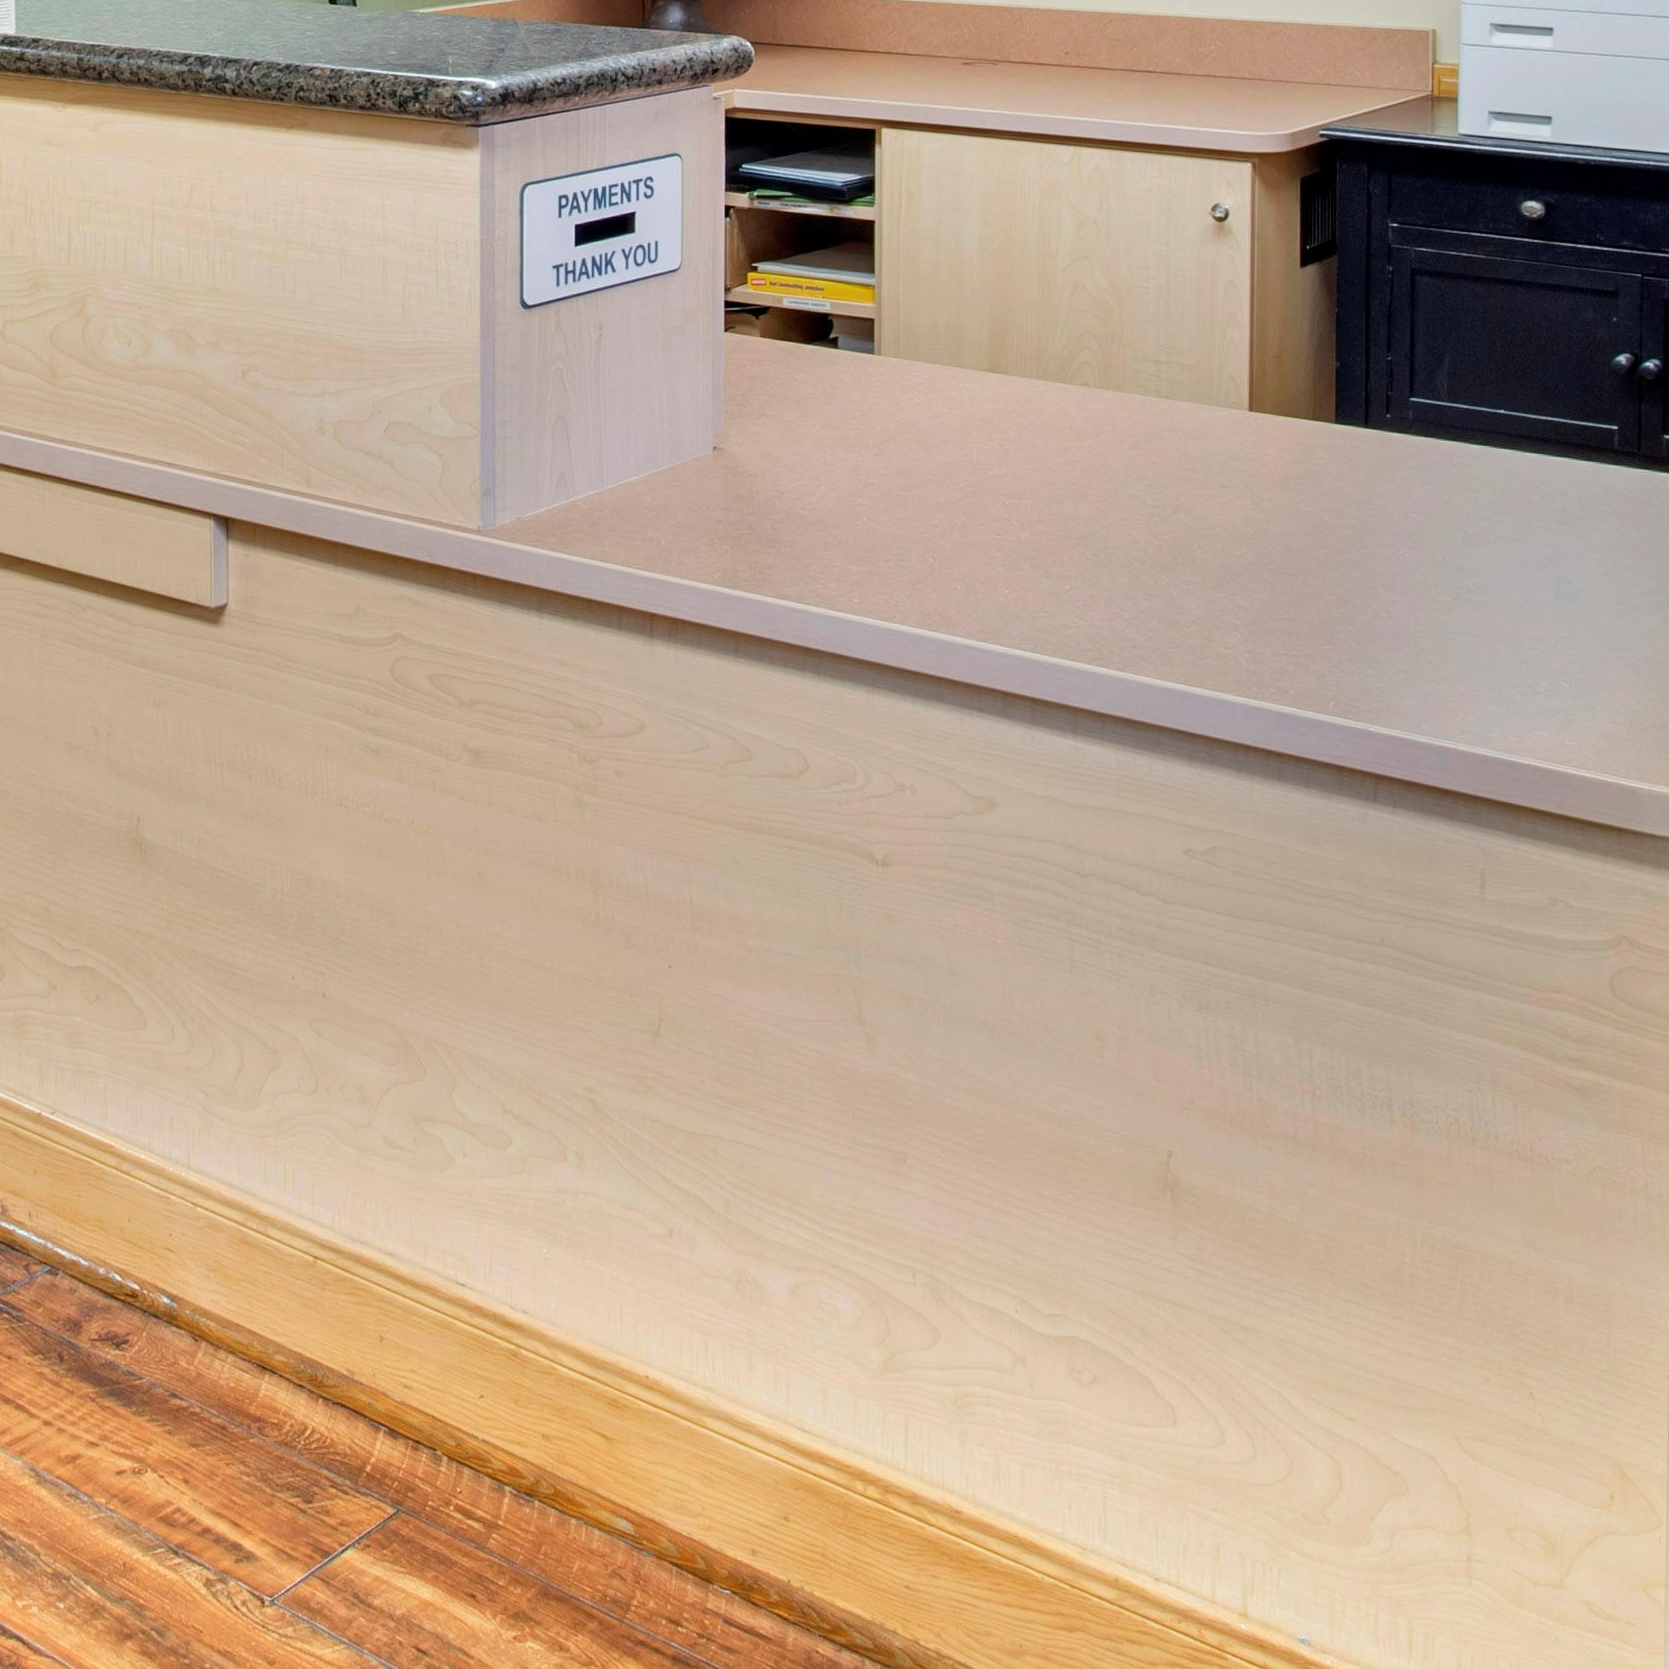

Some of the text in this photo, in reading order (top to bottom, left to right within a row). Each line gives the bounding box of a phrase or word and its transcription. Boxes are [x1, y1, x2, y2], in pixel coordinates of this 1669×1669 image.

[558, 176, 654, 218] PAYMENTS
[553, 241, 659, 287] THANK YOU
